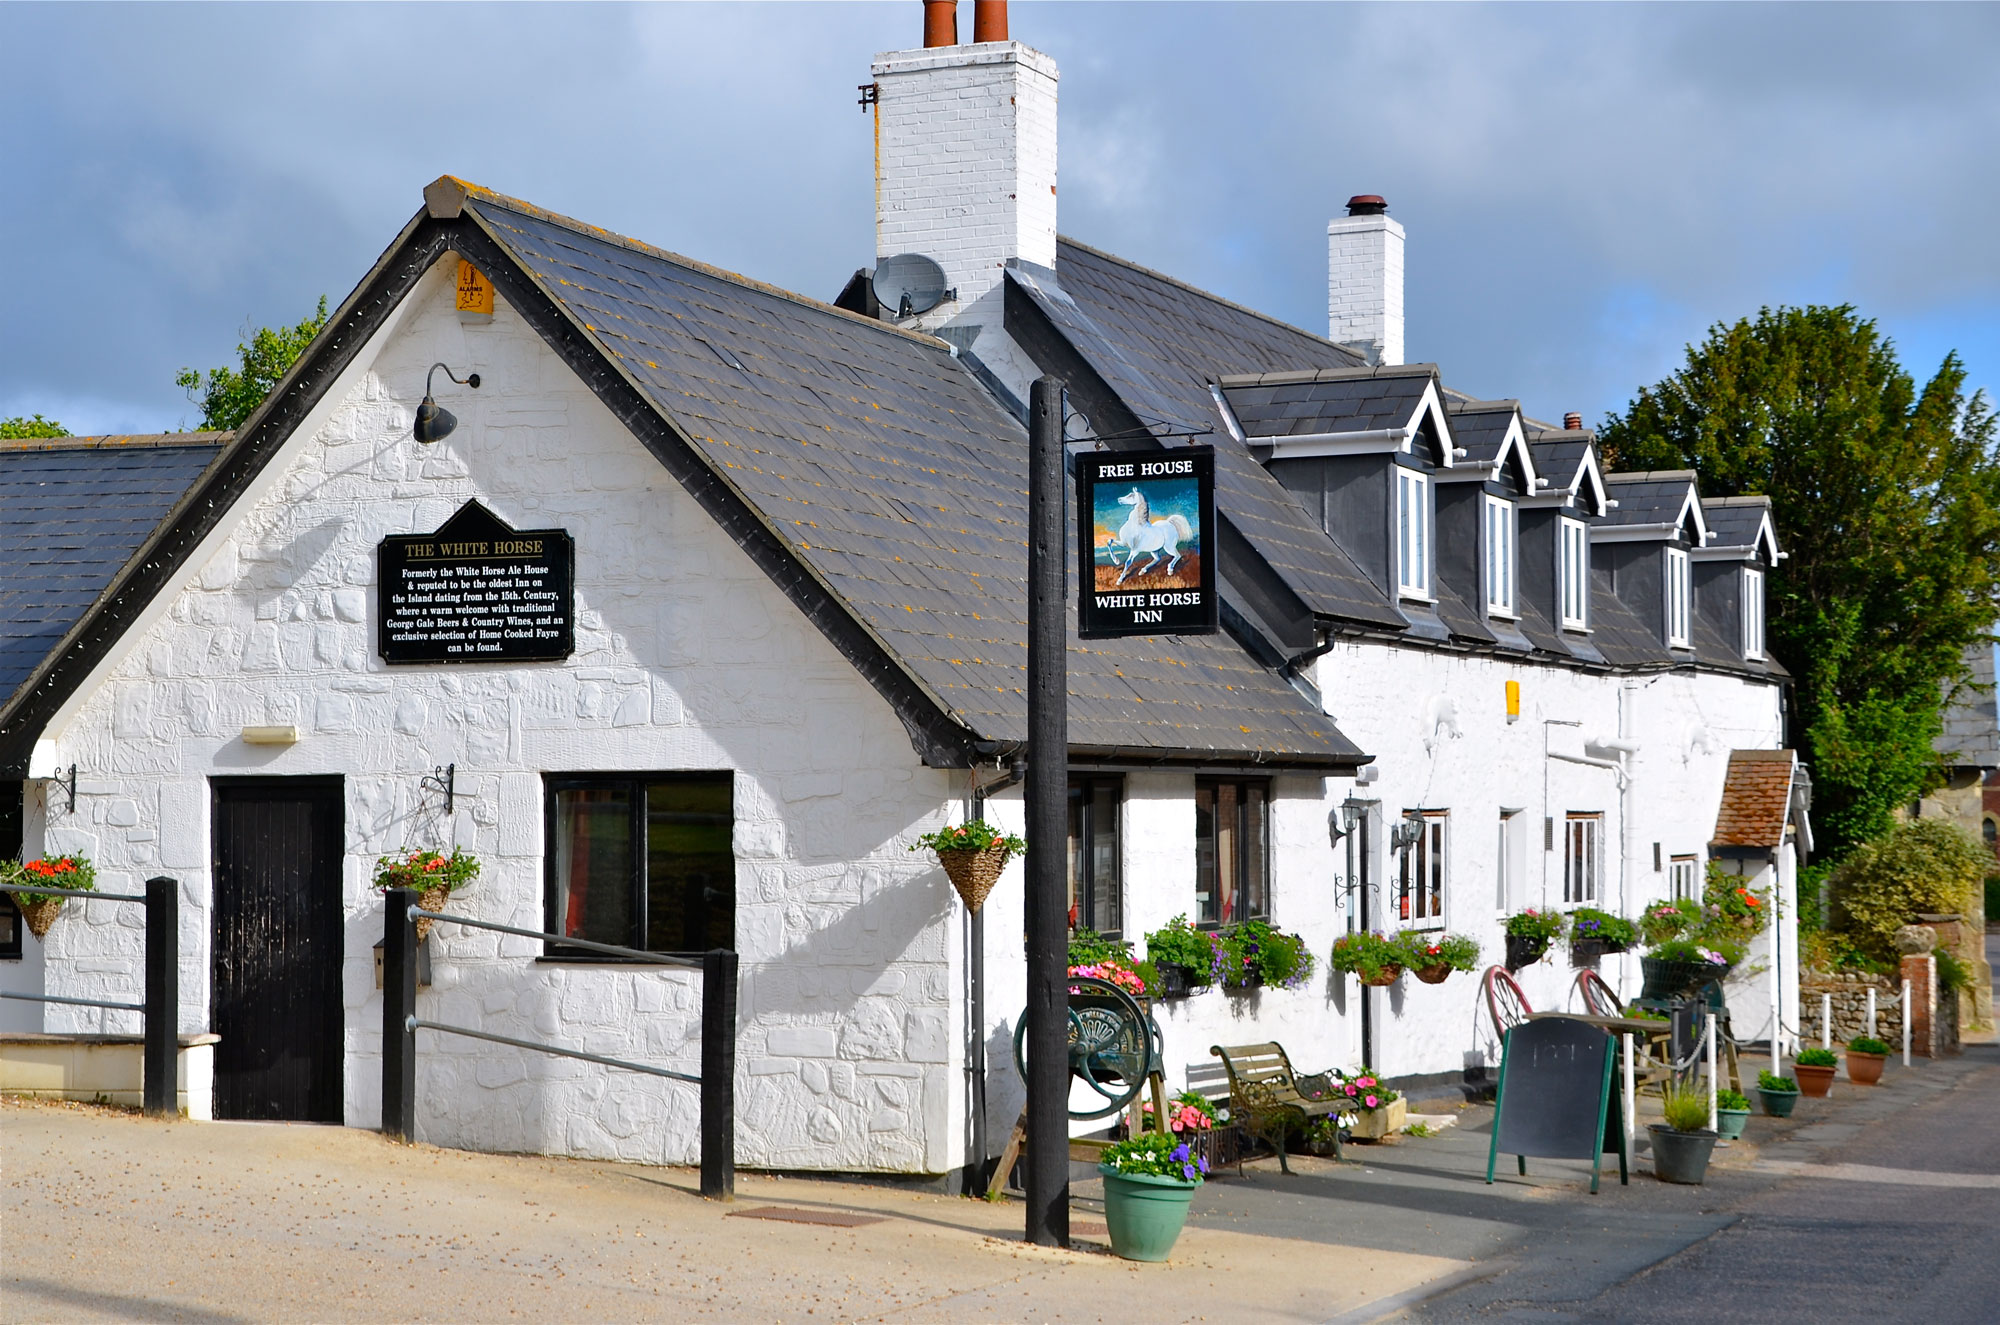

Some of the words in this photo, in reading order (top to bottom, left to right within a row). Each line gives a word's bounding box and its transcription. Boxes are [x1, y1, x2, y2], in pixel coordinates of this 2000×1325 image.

[1099, 464, 1134, 478] FREE
[1141, 461, 1193, 475] HOUSE
[405, 544, 434, 557] THE
[440, 542, 488, 555] WHITE
[494, 540, 543, 554] HORSE
[402, 568, 437, 580] Formerly
[440, 568, 453, 577] the
[456, 566, 480, 576] White
[482, 566, 505, 576] Horse
[508, 566, 521, 575] Ale
[524, 565, 549, 574] House
[407, 581, 414, 590] &
[417, 580, 447, 591] reputed
[450, 580, 458, 589] to
[461, 579, 470, 589] be
[473, 579, 486, 588] the
[489, 578, 513, 588] oldest
[515, 578, 530, 587] Inn
[392, 594, 405, 603] the
[408, 593, 432, 602] Island
[435, 593, 460, 603] dating
[463, 592, 482, 601] from
[485, 592, 498, 601] the
[501, 591, 521, 600] 15th.
[524, 590, 559, 601] Century,
[1095, 595, 1145, 608] WHITE
[1149, 593, 1201, 607] HORSE
[396, 605, 419, 615] where
[455, 604, 489, 614] welcome
[492, 604, 510, 613] with
[512, 602, 555, 612] traditional
[387, 619, 414, 630] George
[417, 618, 434, 628] Gale
[437, 618, 459, 627] Beers
[462, 618, 469, 627] &
[471, 617, 504, 628] Country
[507, 616, 534, 627] Wines,
[536, 616, 551, 625] and
[1133, 610, 1163, 623] INN
[392, 631, 428, 641] exclusive
[431, 630, 465, 640] selection
[468, 630, 478, 639] of
[479, 630, 501, 639] Home
[504, 629, 533, 638] Cooked
[536, 628, 559, 639] Fayre
[465, 643, 474, 652] be
[477, 642, 503, 652] found.
